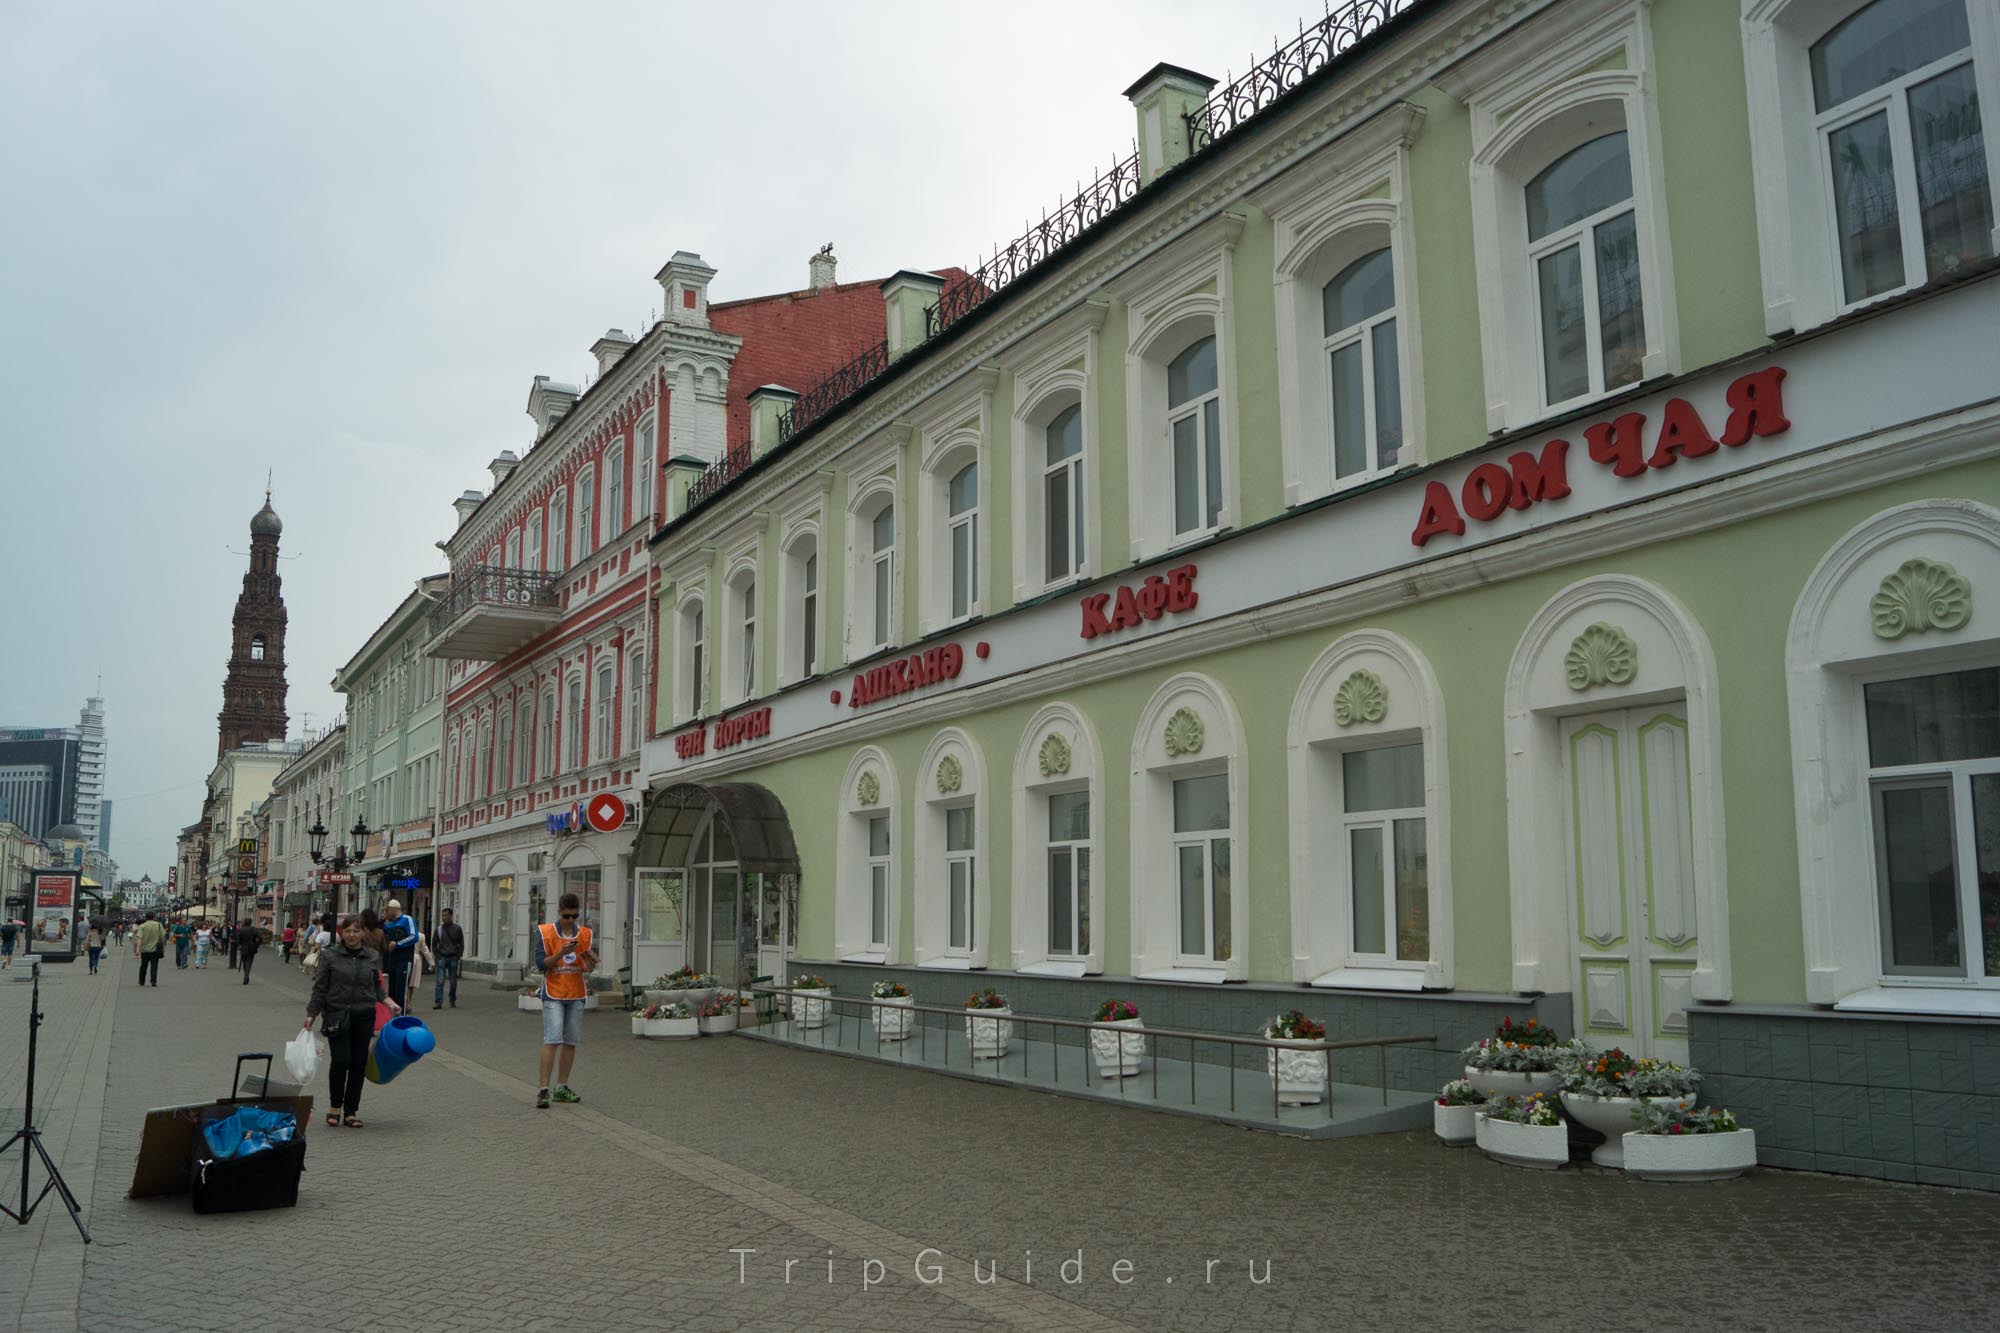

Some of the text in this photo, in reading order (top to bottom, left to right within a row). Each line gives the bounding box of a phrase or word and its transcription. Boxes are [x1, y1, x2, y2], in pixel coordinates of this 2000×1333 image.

[1411, 367, 1791, 547] ДОМ ЧАЯ
[1080, 564, 1198, 639] КАФЕ
